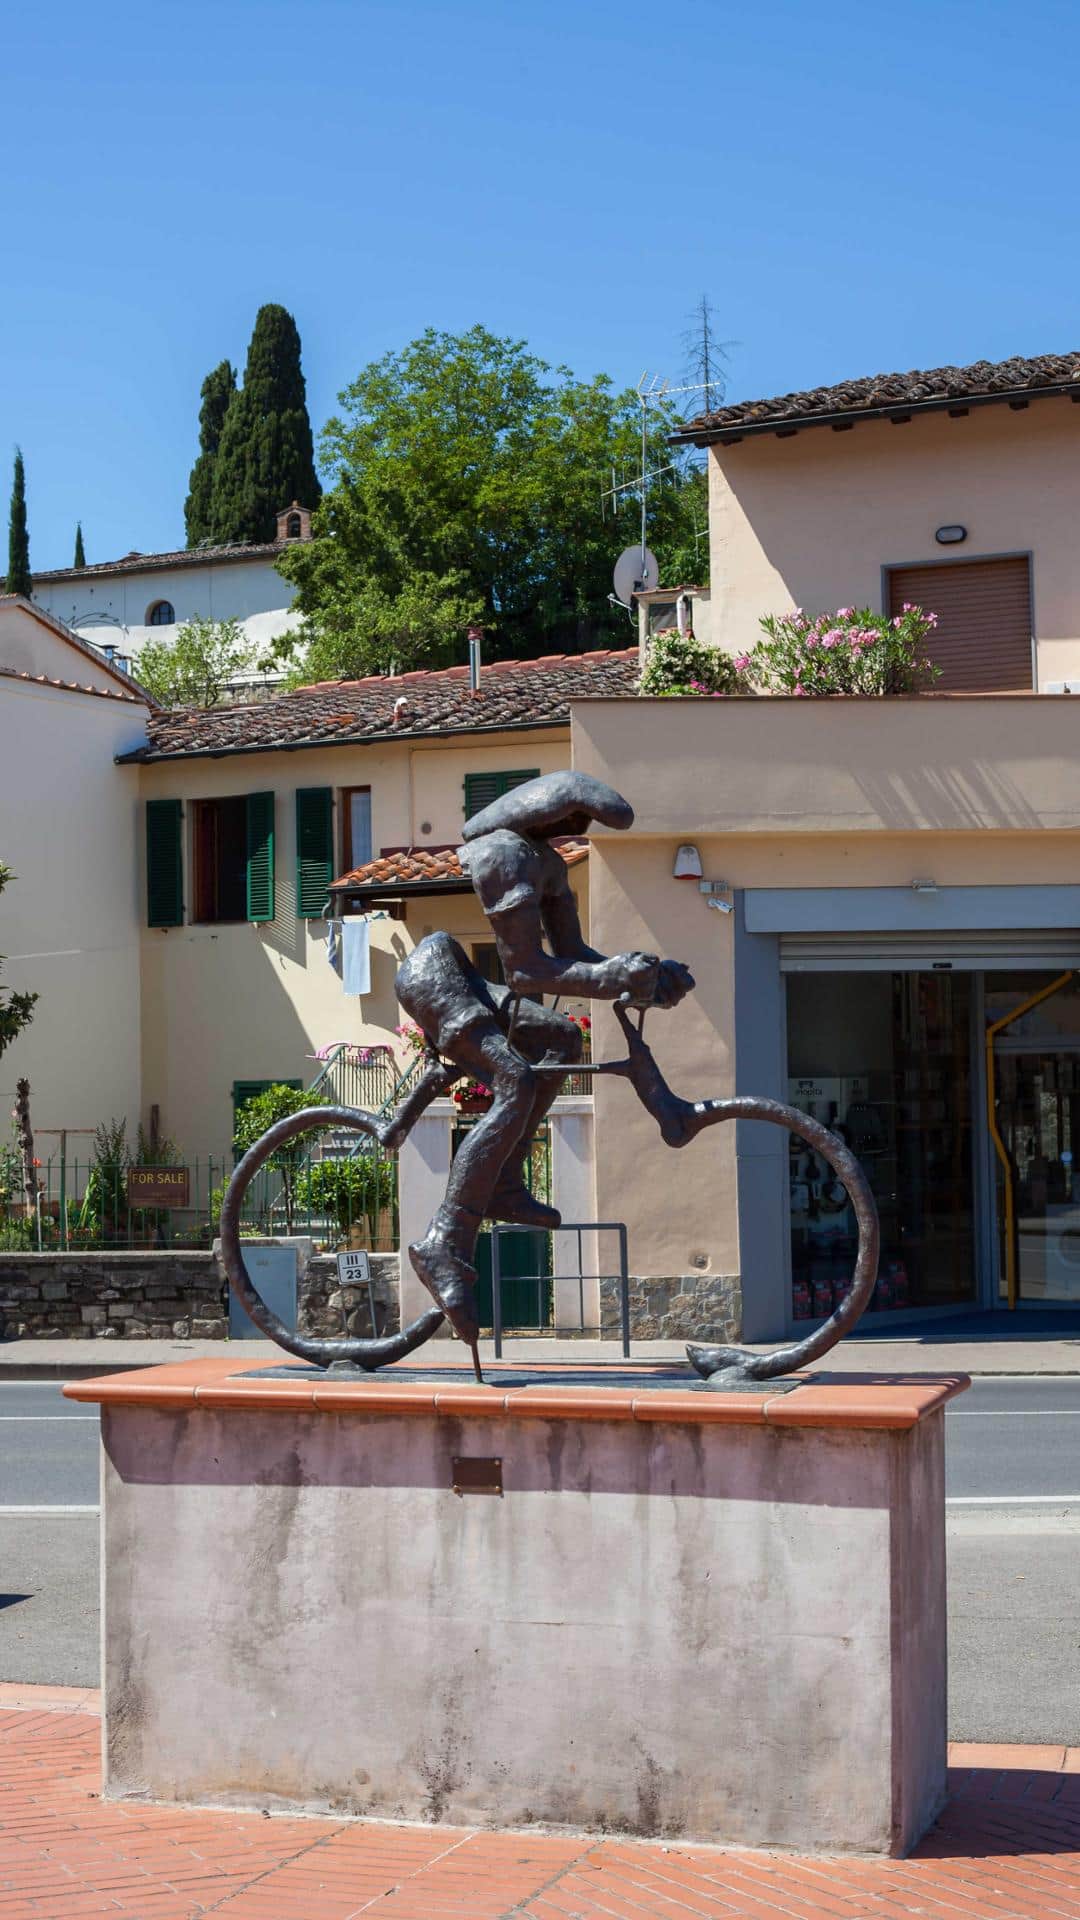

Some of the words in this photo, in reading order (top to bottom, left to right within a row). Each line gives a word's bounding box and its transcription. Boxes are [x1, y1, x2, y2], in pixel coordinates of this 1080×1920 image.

[132, 1173, 154, 1184] FOR
[157, 1173, 184, 1184] SALE
[346, 1269, 362, 1279] 23
